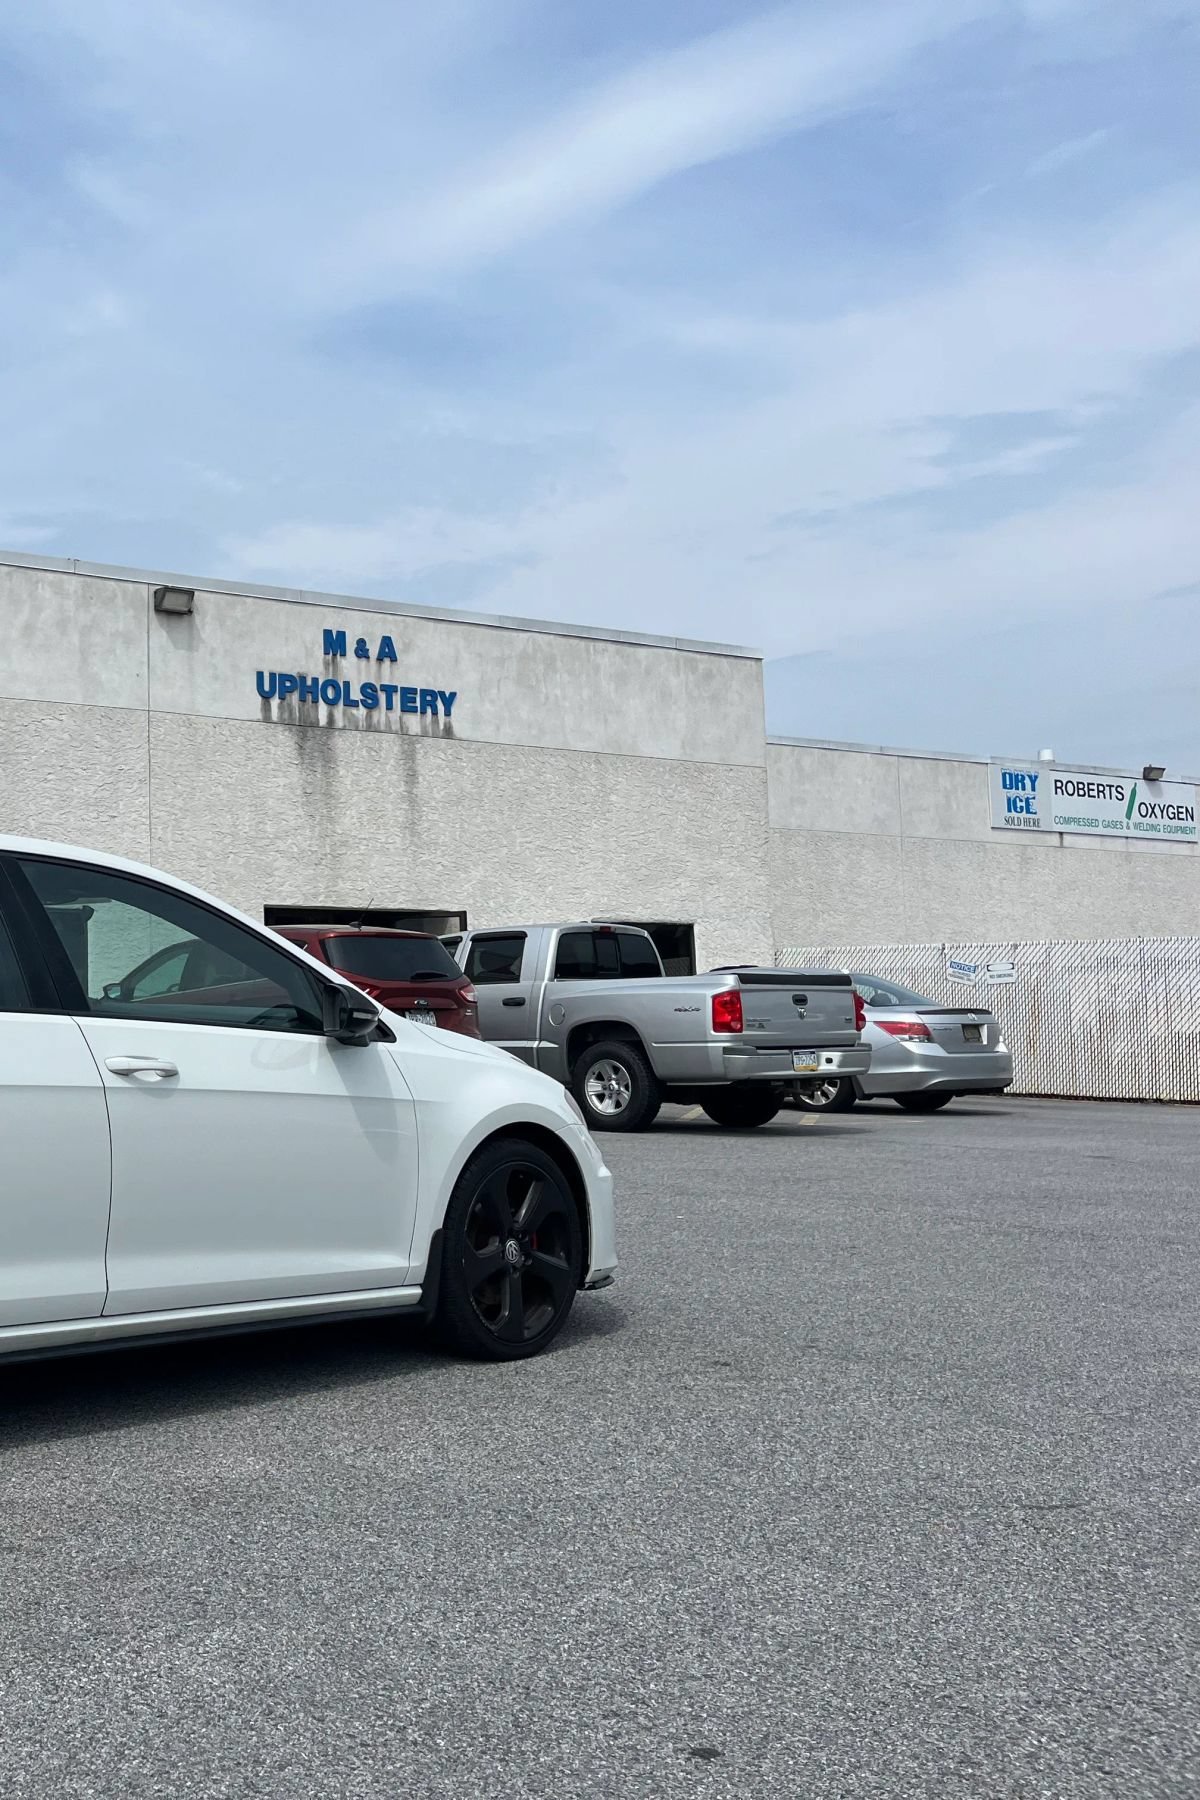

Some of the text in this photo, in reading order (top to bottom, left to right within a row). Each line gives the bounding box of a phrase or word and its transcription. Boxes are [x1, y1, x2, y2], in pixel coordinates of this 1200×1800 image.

[322, 628, 398, 662] M & A
[256, 671, 457, 717] UPHOLSTERY
[1001, 768, 1039, 792] DRY
[1053, 778, 1125, 802] ROBERTS
[1006, 793, 1038, 815] ICE
[1137, 801, 1196, 823] OXYGEN
[1004, 816, 1040, 828] SOLD HERE
[1053, 815, 1197, 836] COMPRESSED GASES & WELDING EQUIPMENT
[950, 961, 976, 973] NOTICE
